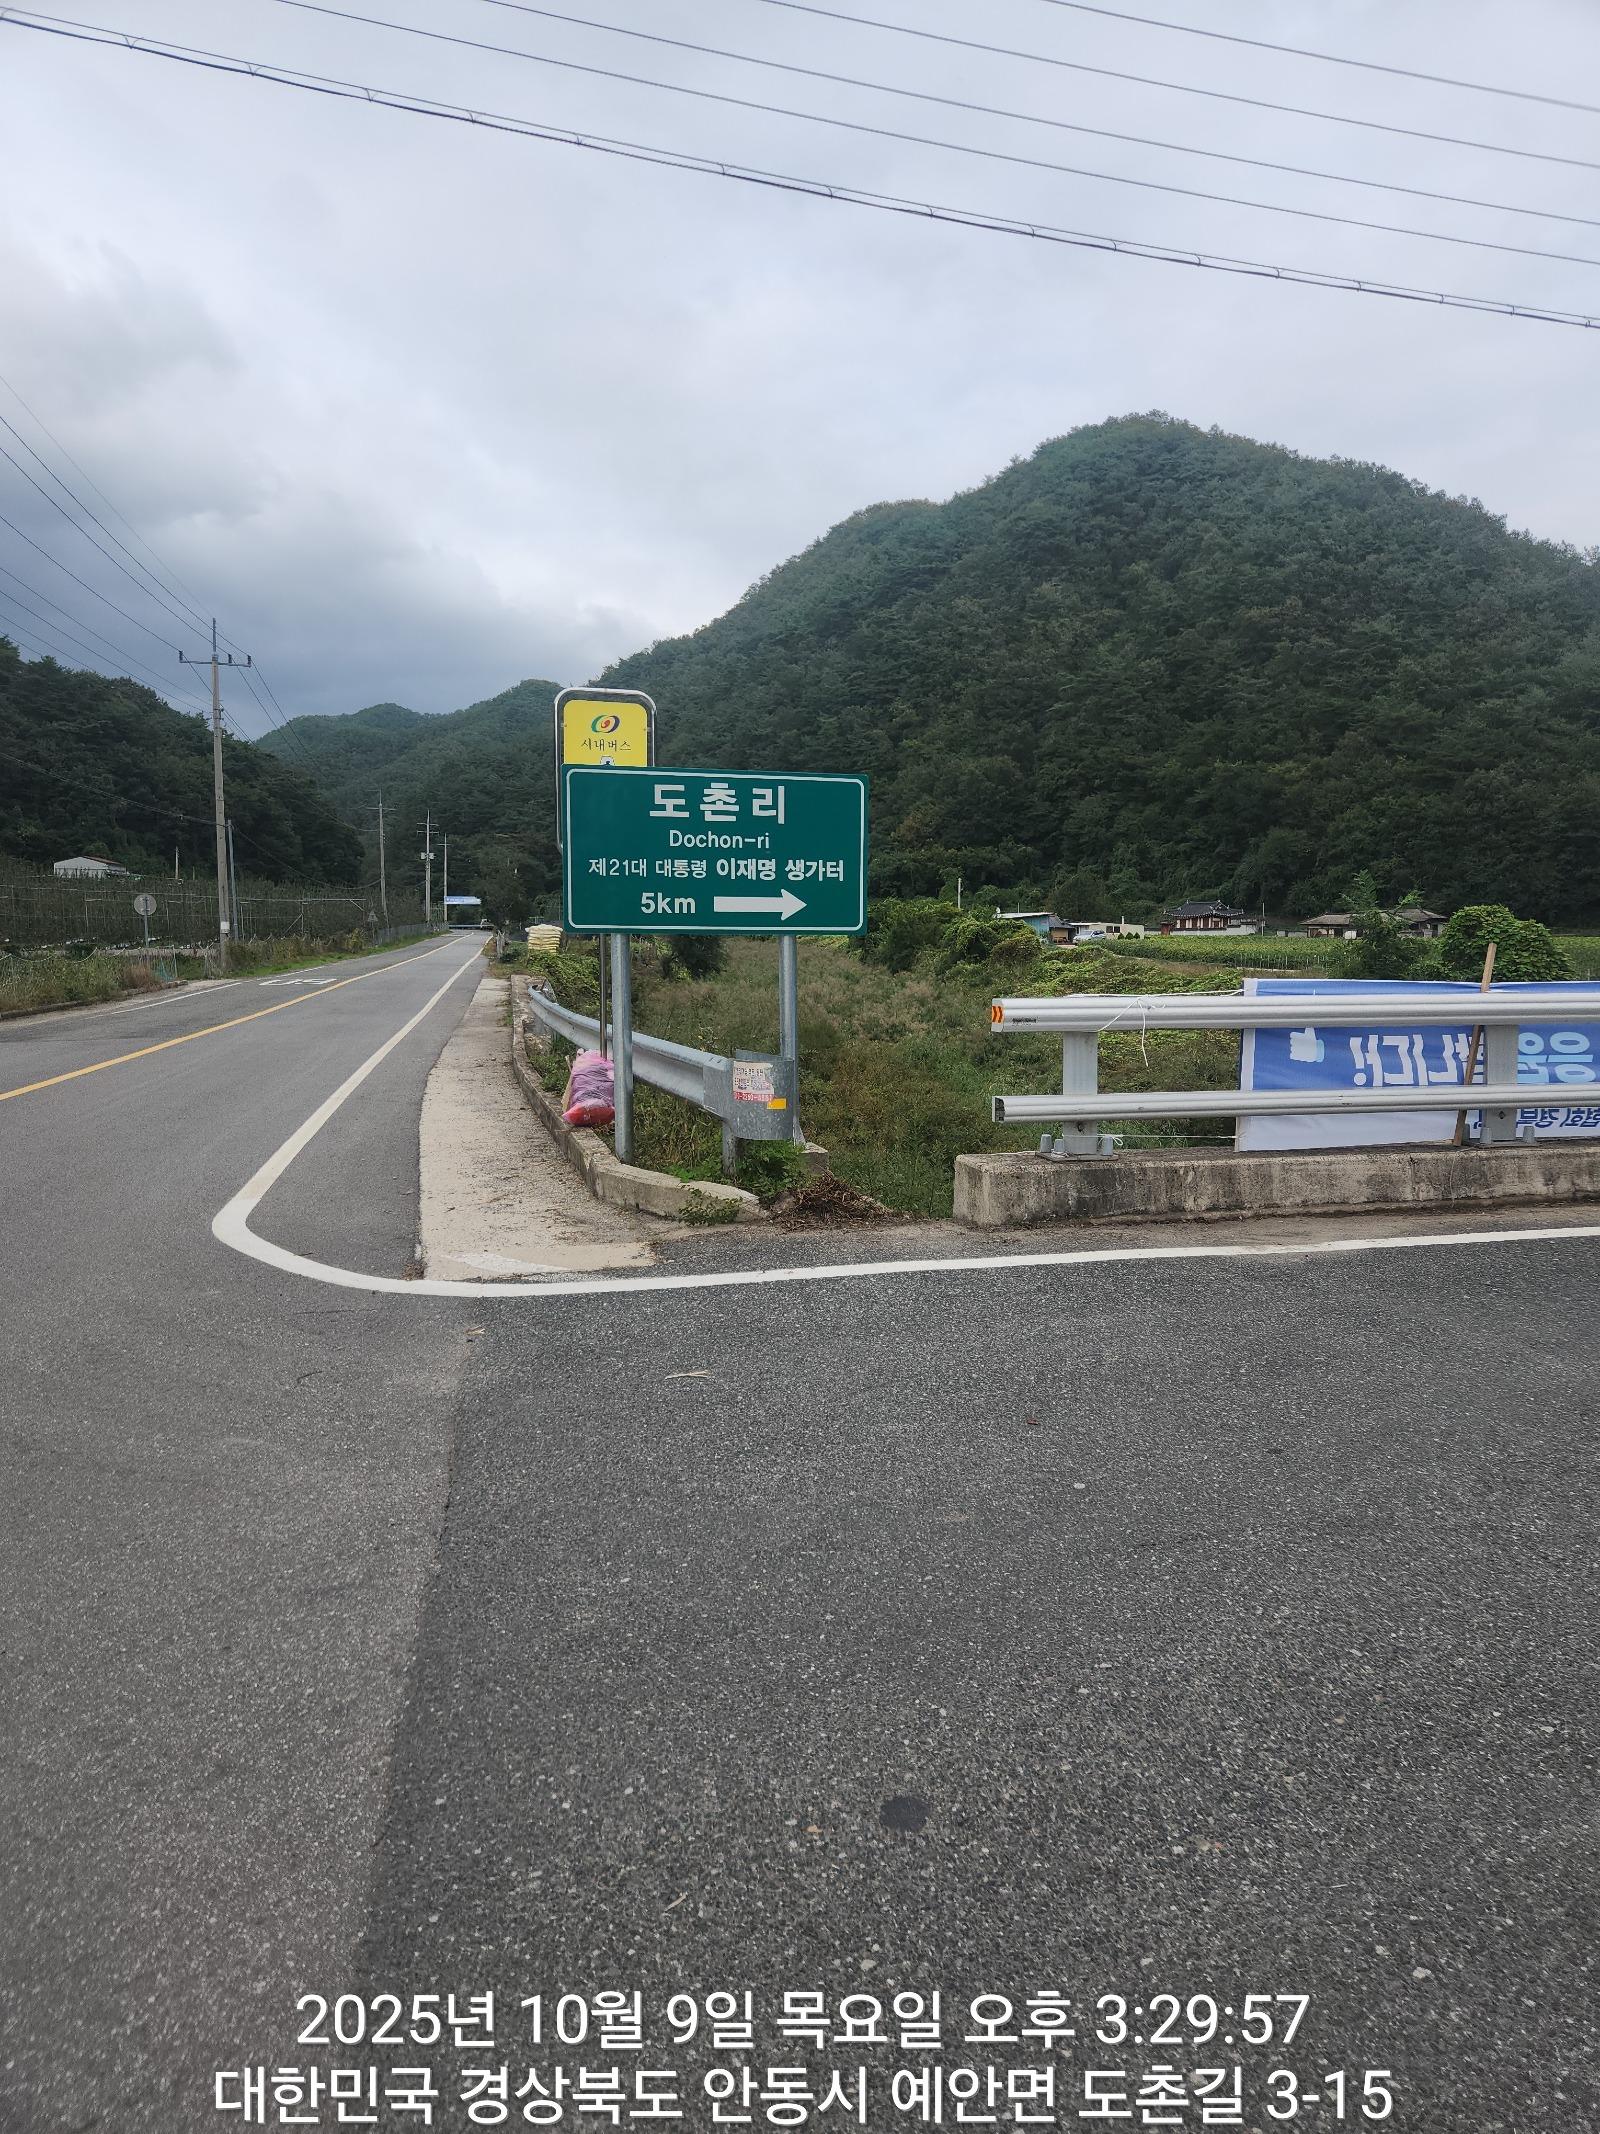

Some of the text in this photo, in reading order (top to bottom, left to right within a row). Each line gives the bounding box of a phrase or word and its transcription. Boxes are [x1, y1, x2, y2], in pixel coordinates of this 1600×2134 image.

[581, 737, 632, 752] 시내버스
[649, 782, 785, 825] 도촌리
[669, 829, 770, 849] Dochon-ri
[588, 857, 844, 882] 제21대 대통령 이재명 생가터
[640, 892, 696, 915] 5km
